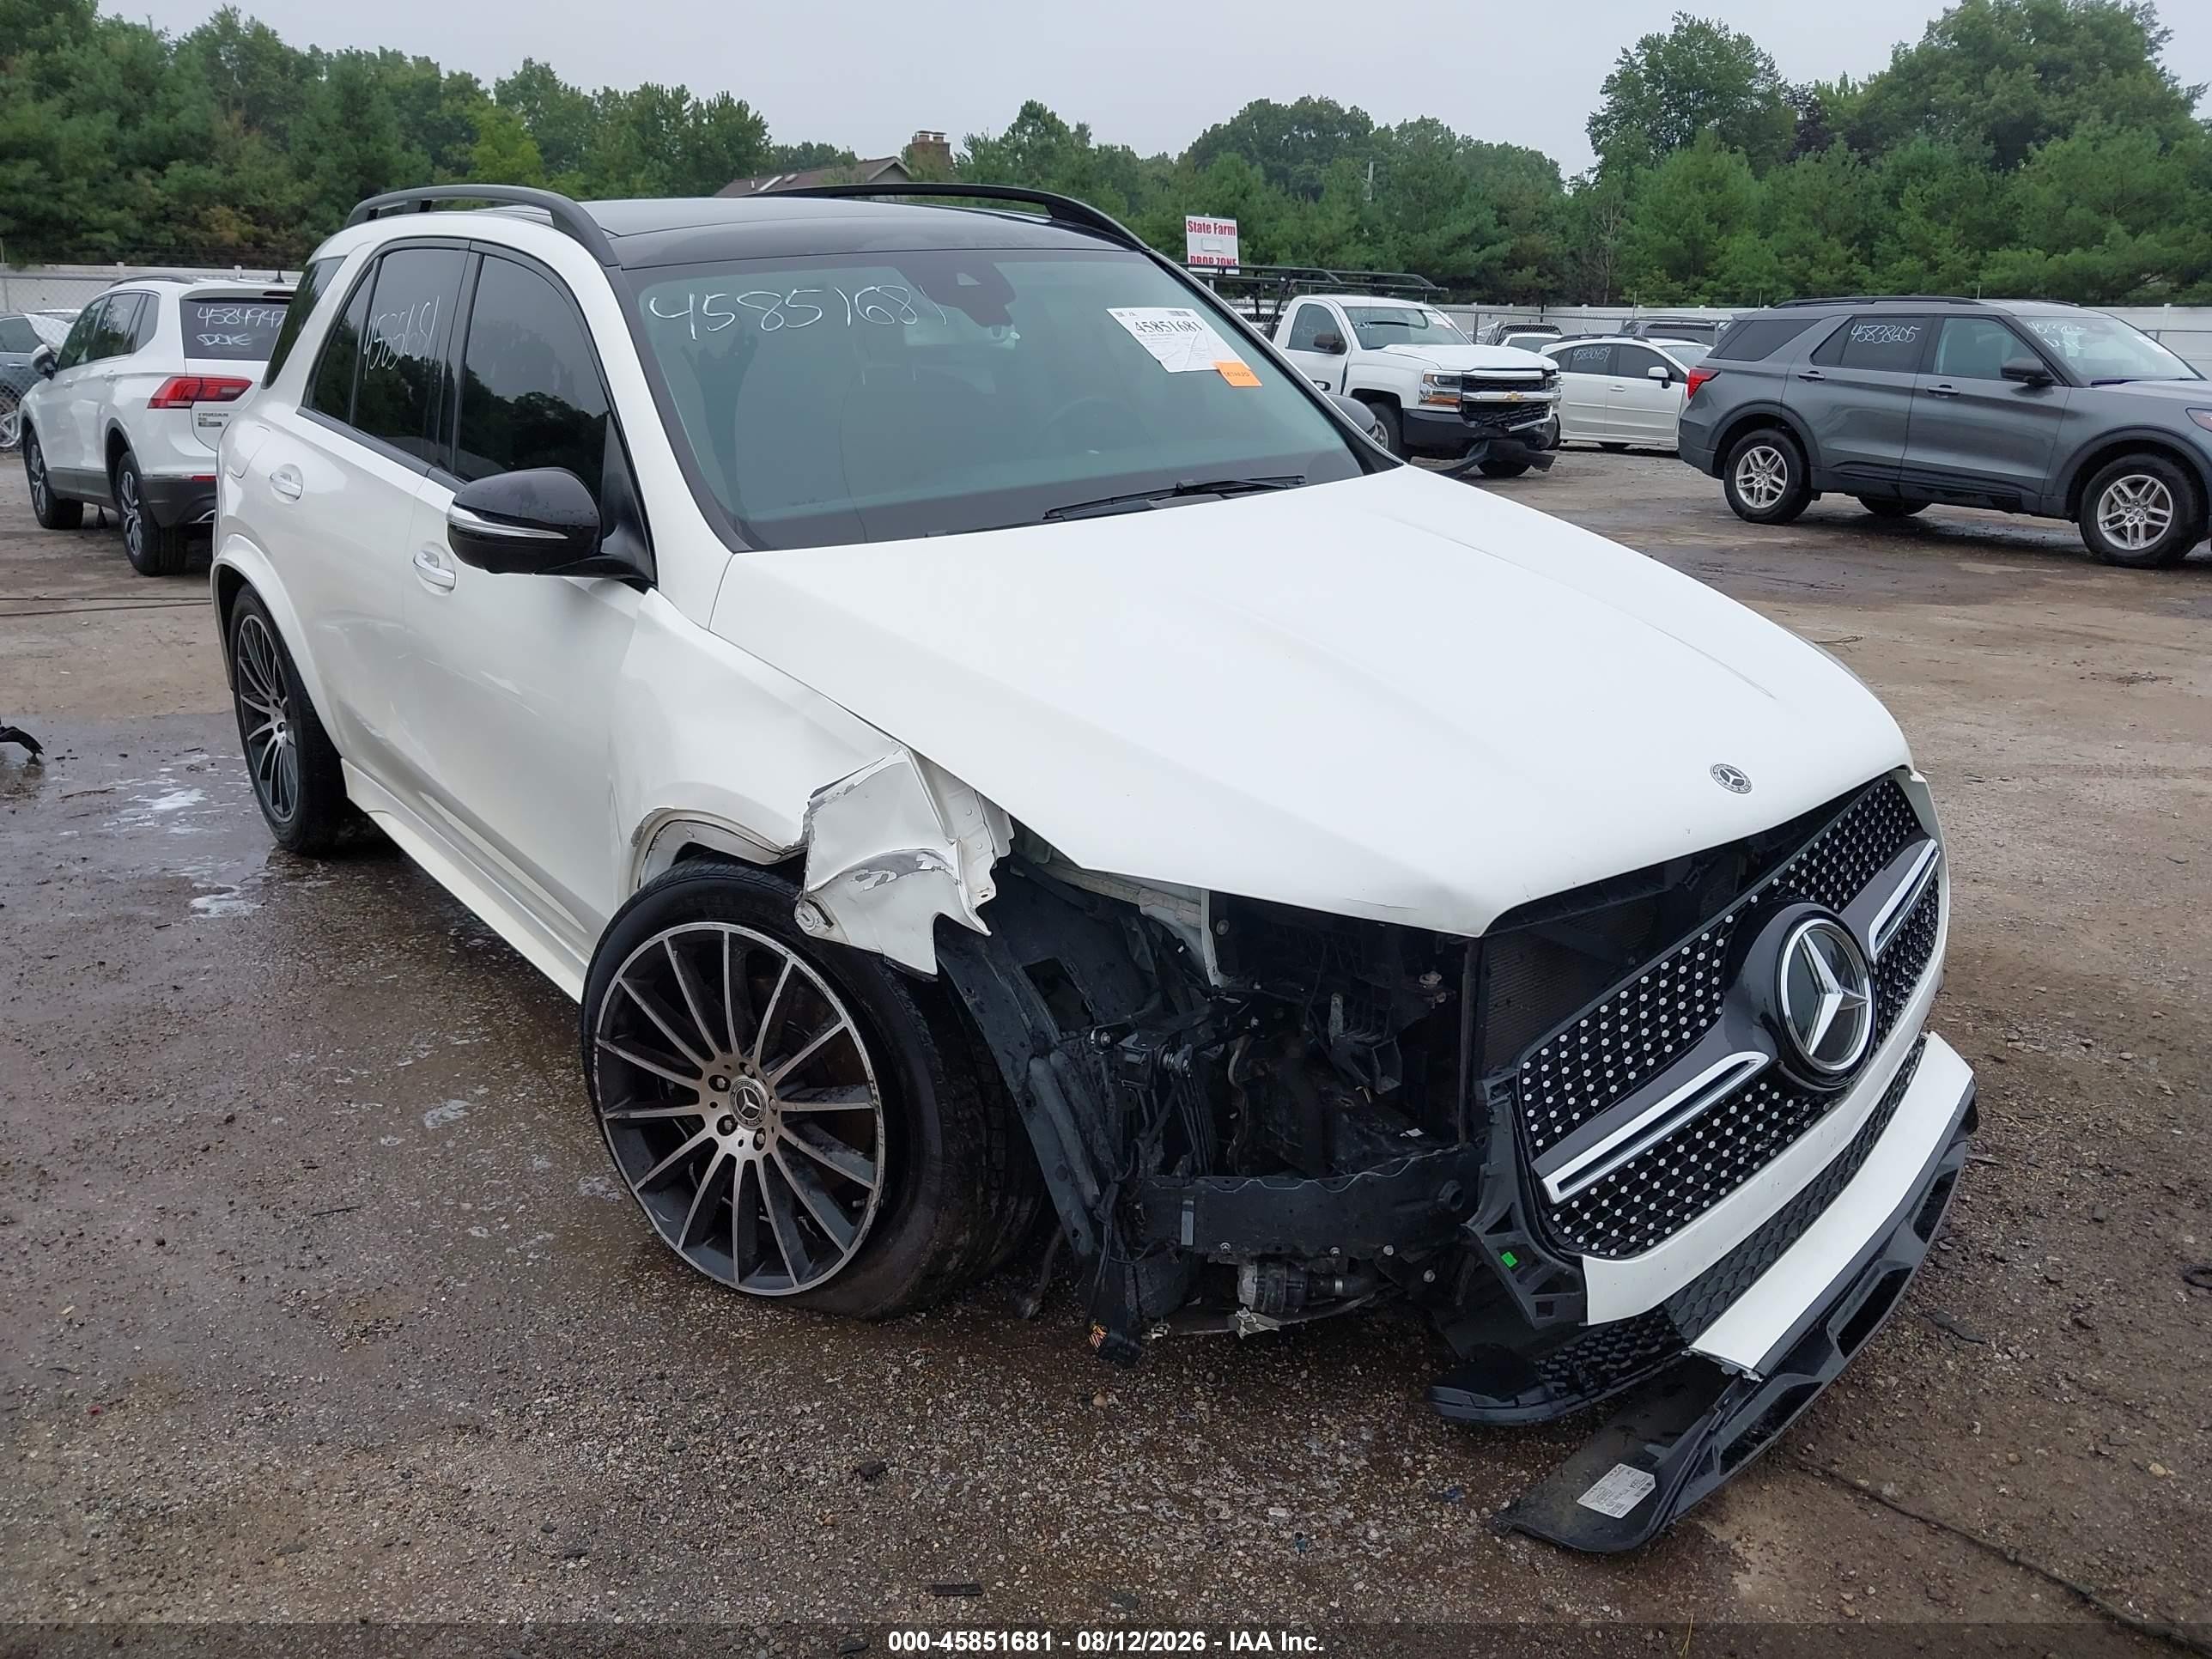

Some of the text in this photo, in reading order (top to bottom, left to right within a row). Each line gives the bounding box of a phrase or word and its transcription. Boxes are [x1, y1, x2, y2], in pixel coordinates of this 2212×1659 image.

[1188, 221, 1236, 236] State Farm
[1190, 256, 1214, 265] DROP
[648, 285, 947, 341] 45851681
[1133, 320, 1203, 333] 45851681
